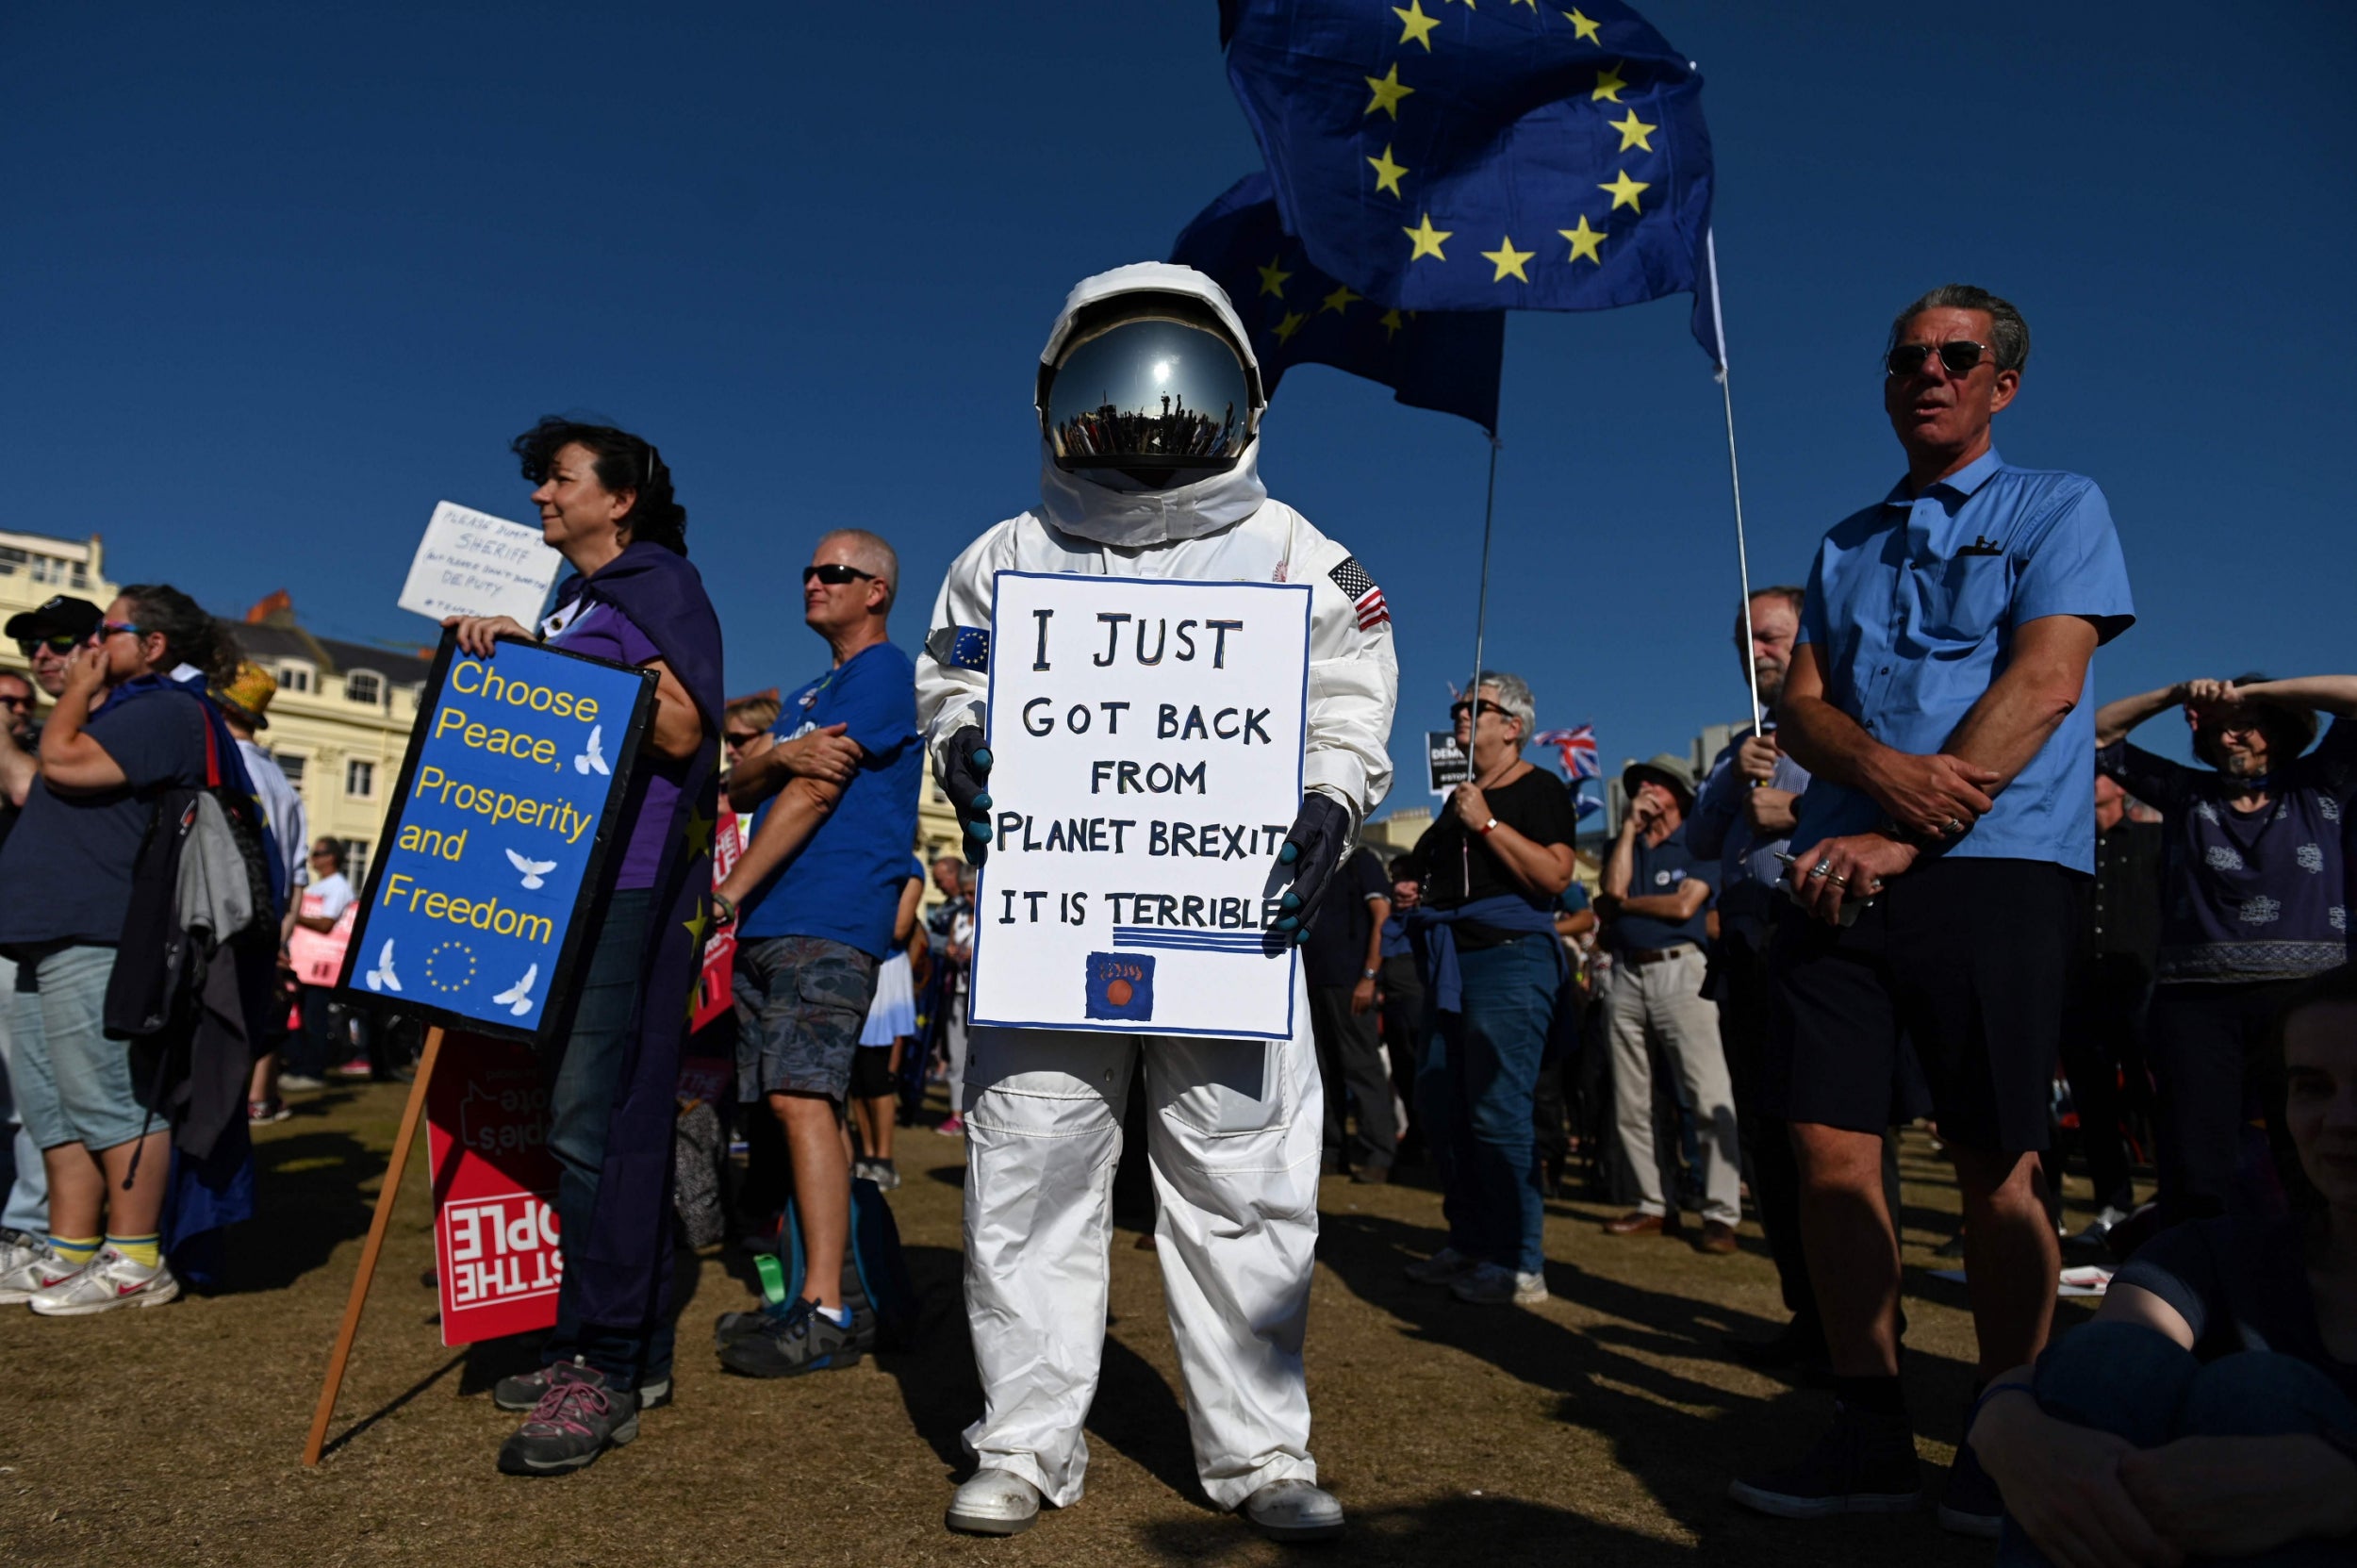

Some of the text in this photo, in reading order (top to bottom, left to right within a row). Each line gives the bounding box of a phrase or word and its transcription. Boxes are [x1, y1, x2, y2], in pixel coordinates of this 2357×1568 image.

[454, 533, 530, 564] SHERIFF
[441, 569, 503, 598] DEPUTY
[1032, 608, 1244, 671] I JUST
[451, 660, 599, 723] Choose
[434, 707, 563, 772] Peace,
[1022, 697, 1272, 745] GOT BACK
[1091, 760, 1207, 795] FROM
[414, 766, 593, 845] Prosperity
[399, 824, 468, 862] and
[996, 812, 1288, 861] PLANET BREXIT
[383, 873, 553, 945] Freedom
[997, 889, 1281, 931] IT IS TERRIBLE
[454, 1256, 529, 1303] THE
